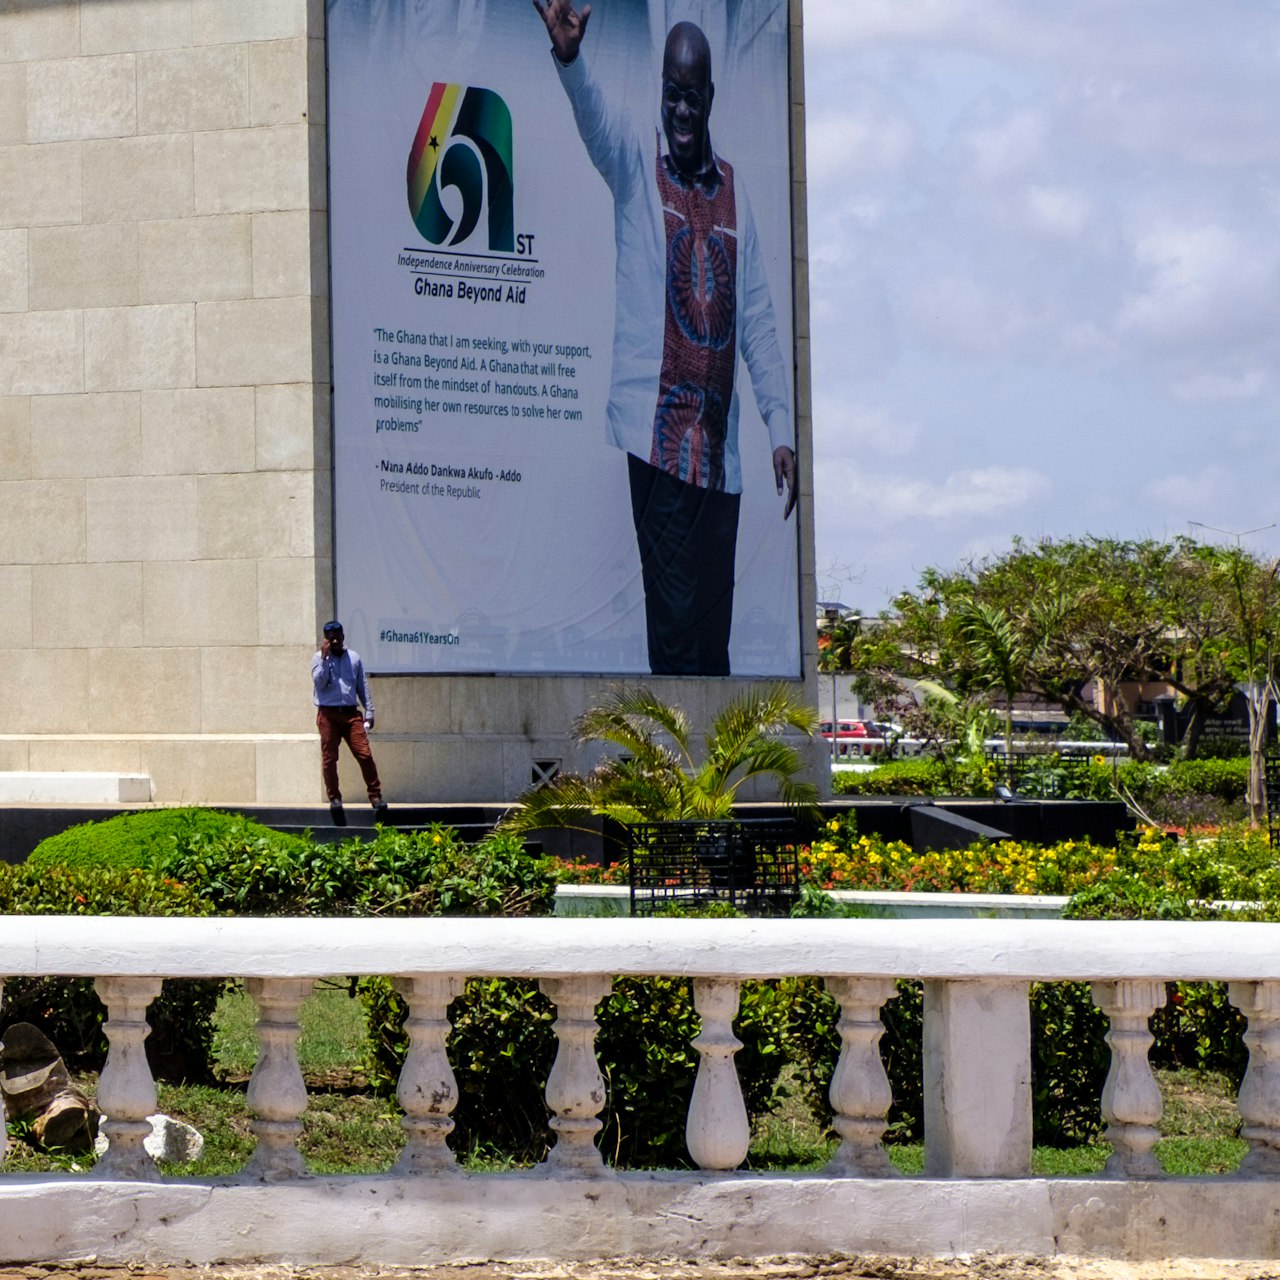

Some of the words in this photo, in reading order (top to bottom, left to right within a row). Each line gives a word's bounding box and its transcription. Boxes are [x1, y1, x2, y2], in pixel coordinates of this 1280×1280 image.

[398, 254, 452, 270] Independence
[454, 260, 500, 276] Anniversary
[502, 263, 544, 278] Celebration
[415, 278, 453, 298] Ghana
[458, 282, 502, 304] Beyond
[506, 286, 526, 304] Aid
[397, 330, 426, 345] Ghana
[429, 333, 448, 346] that
[451, 335, 453, 347] I
[456, 338, 470, 348] am
[511, 339, 531, 352] with
[533, 344, 553, 356] your
[555, 344, 592, 359] support,
[374, 351, 382, 363] is
[384, 355, 389, 364] a
[392, 352, 421, 366] Ghana
[425, 355, 458, 371] Beyond
[460, 358, 477, 370] Aid.
[480, 360, 487, 371] A
[489, 359, 518, 374] Ghana
[521, 362, 538, 375] that
[541, 363, 555, 376] will
[558, 364, 575, 377] free
[374, 373, 397, 386] itself
[399, 373, 421, 388] from
[424, 376, 439, 389] the
[442, 377, 478, 393] mindset
[481, 381, 490, 393] of
[495, 381, 539, 397] handouts.
[542, 385, 548, 397] A
[550, 385, 578, 399] Ghana
[375, 395, 422, 413] mobilising
[425, 399, 440, 411] her
[443, 401, 461, 413] own
[465, 404, 508, 416] resources
[511, 406, 519, 416] to
[522, 405, 544, 418] solve
[547, 406, 561, 419] her
[564, 409, 582, 420] own
[381, 460, 403, 473] Nana
[406, 463, 428, 475] Addo
[431, 464, 465, 478] Dankwa
[468, 467, 493, 480] Akufo
[380, 479, 419, 494] President
[422, 484, 430, 495] of
[432, 483, 444, 495] the
[447, 485, 481, 500] Republic
[380, 630, 459, 645] #Ghana61YearsOn
